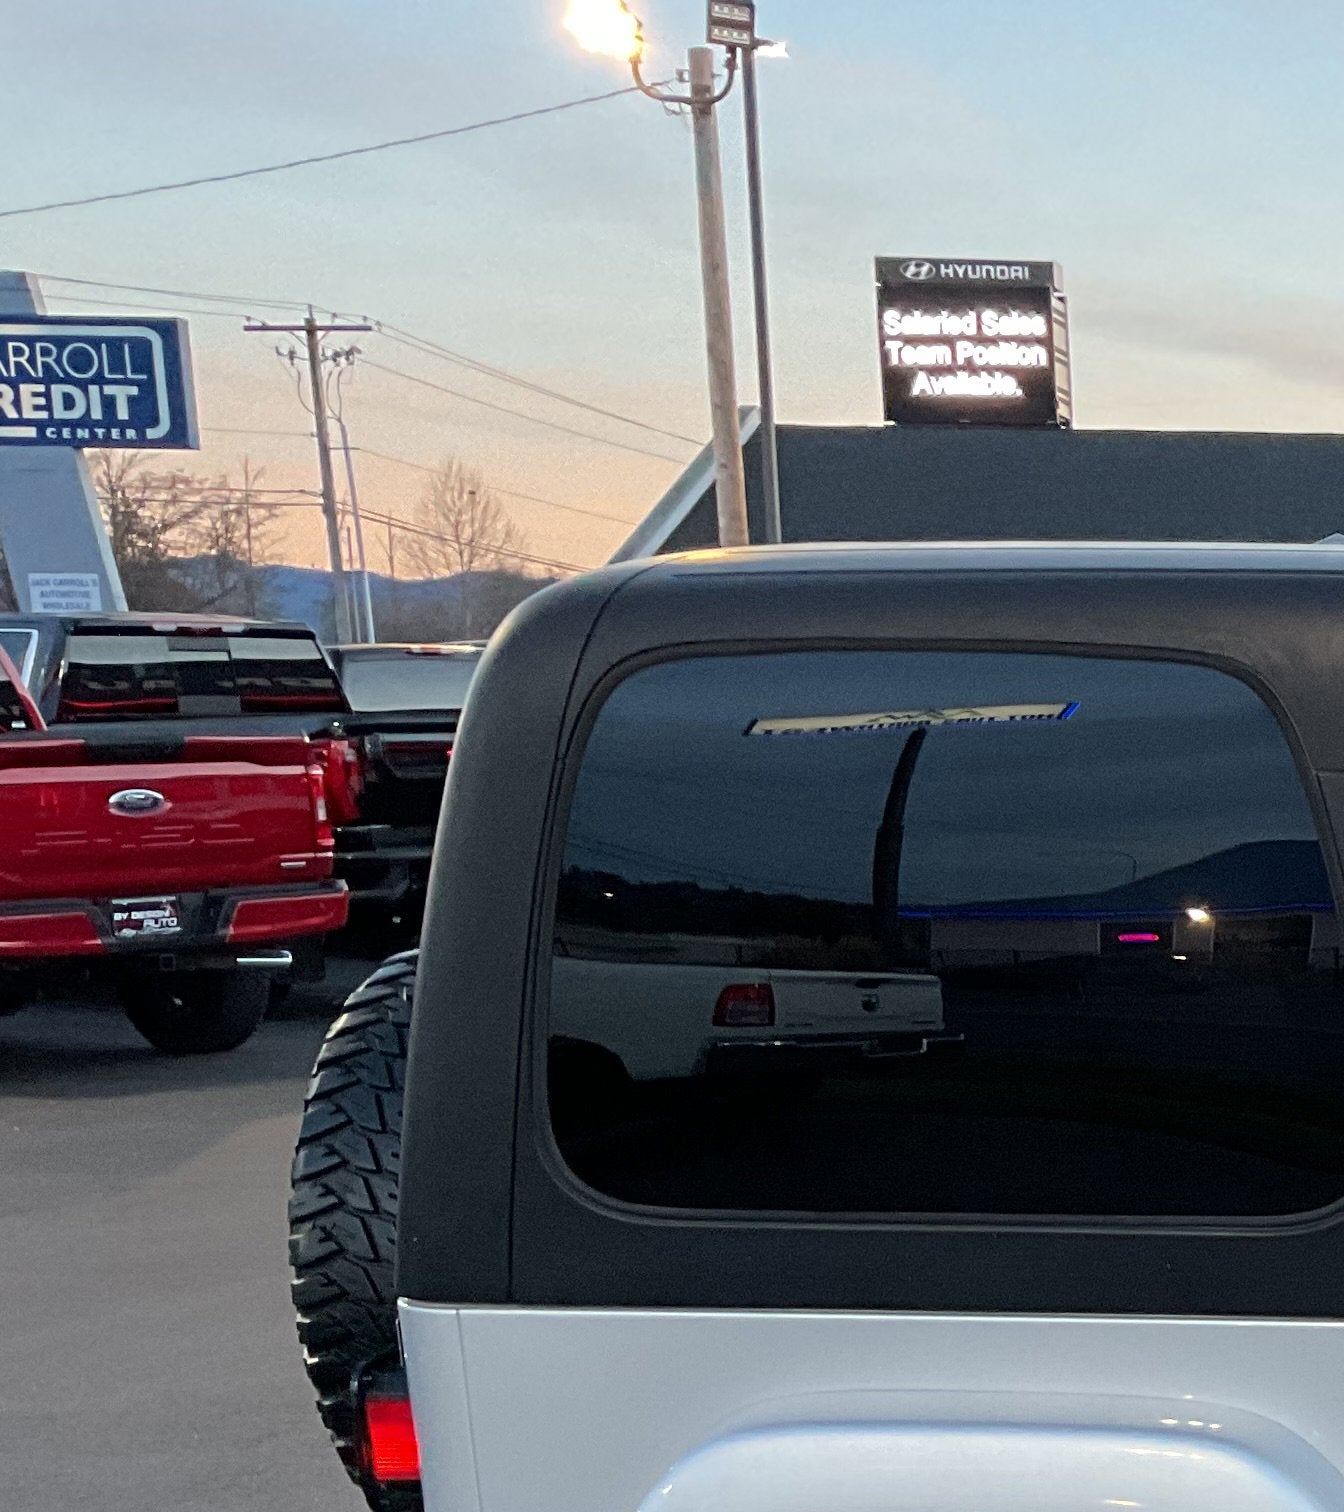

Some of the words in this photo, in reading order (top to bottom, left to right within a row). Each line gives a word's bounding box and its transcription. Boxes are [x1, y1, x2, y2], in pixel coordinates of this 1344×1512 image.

[940, 263, 1030, 280] HYUNDAI
[981, 309, 1047, 336] Sales
[0, 341, 147, 379] RROLL
[885, 340, 952, 366] Team
[956, 340, 1048, 366] Position
[45, 427, 138, 440] CENTER
